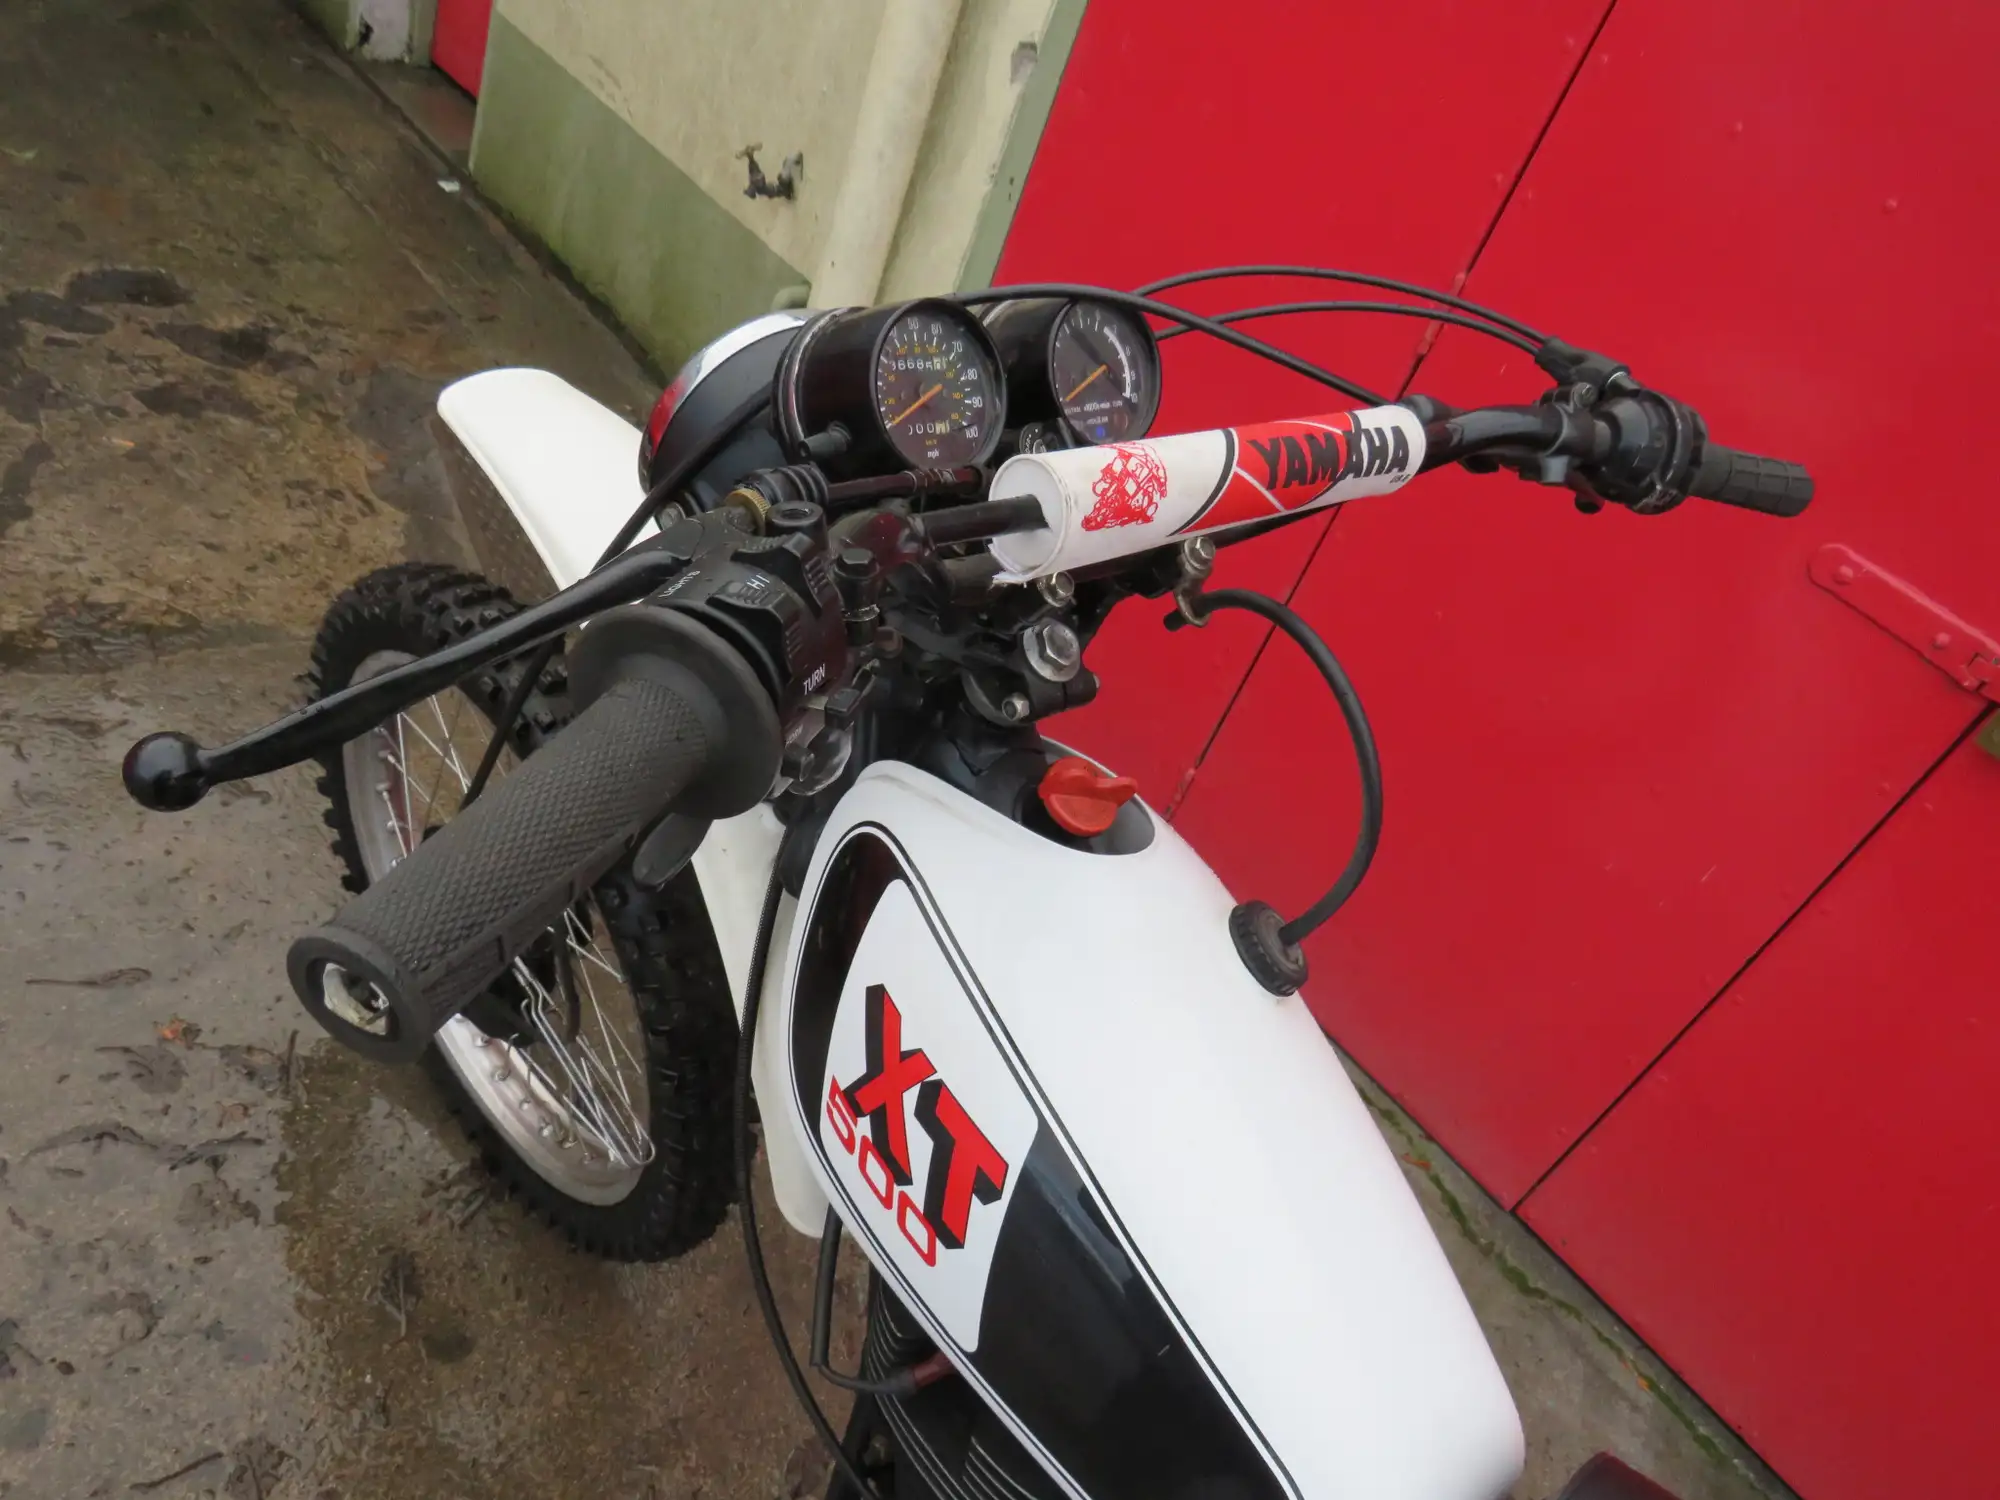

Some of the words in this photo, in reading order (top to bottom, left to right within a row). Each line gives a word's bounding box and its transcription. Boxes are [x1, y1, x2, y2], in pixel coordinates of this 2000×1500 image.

[951, 340, 963, 353] 70
[966, 368, 978, 380] 80
[971, 396, 983, 408] 90
[927, 448, 940, 459] mph
[1247, 425, 1409, 490] YAMAHA
[658, 569, 701, 598] LIGHTS
[745, 573, 771, 590] HI
[803, 663, 826, 696] TURN
[842, 983, 1009, 1250] XT
[826, 1074, 937, 1268] 500
